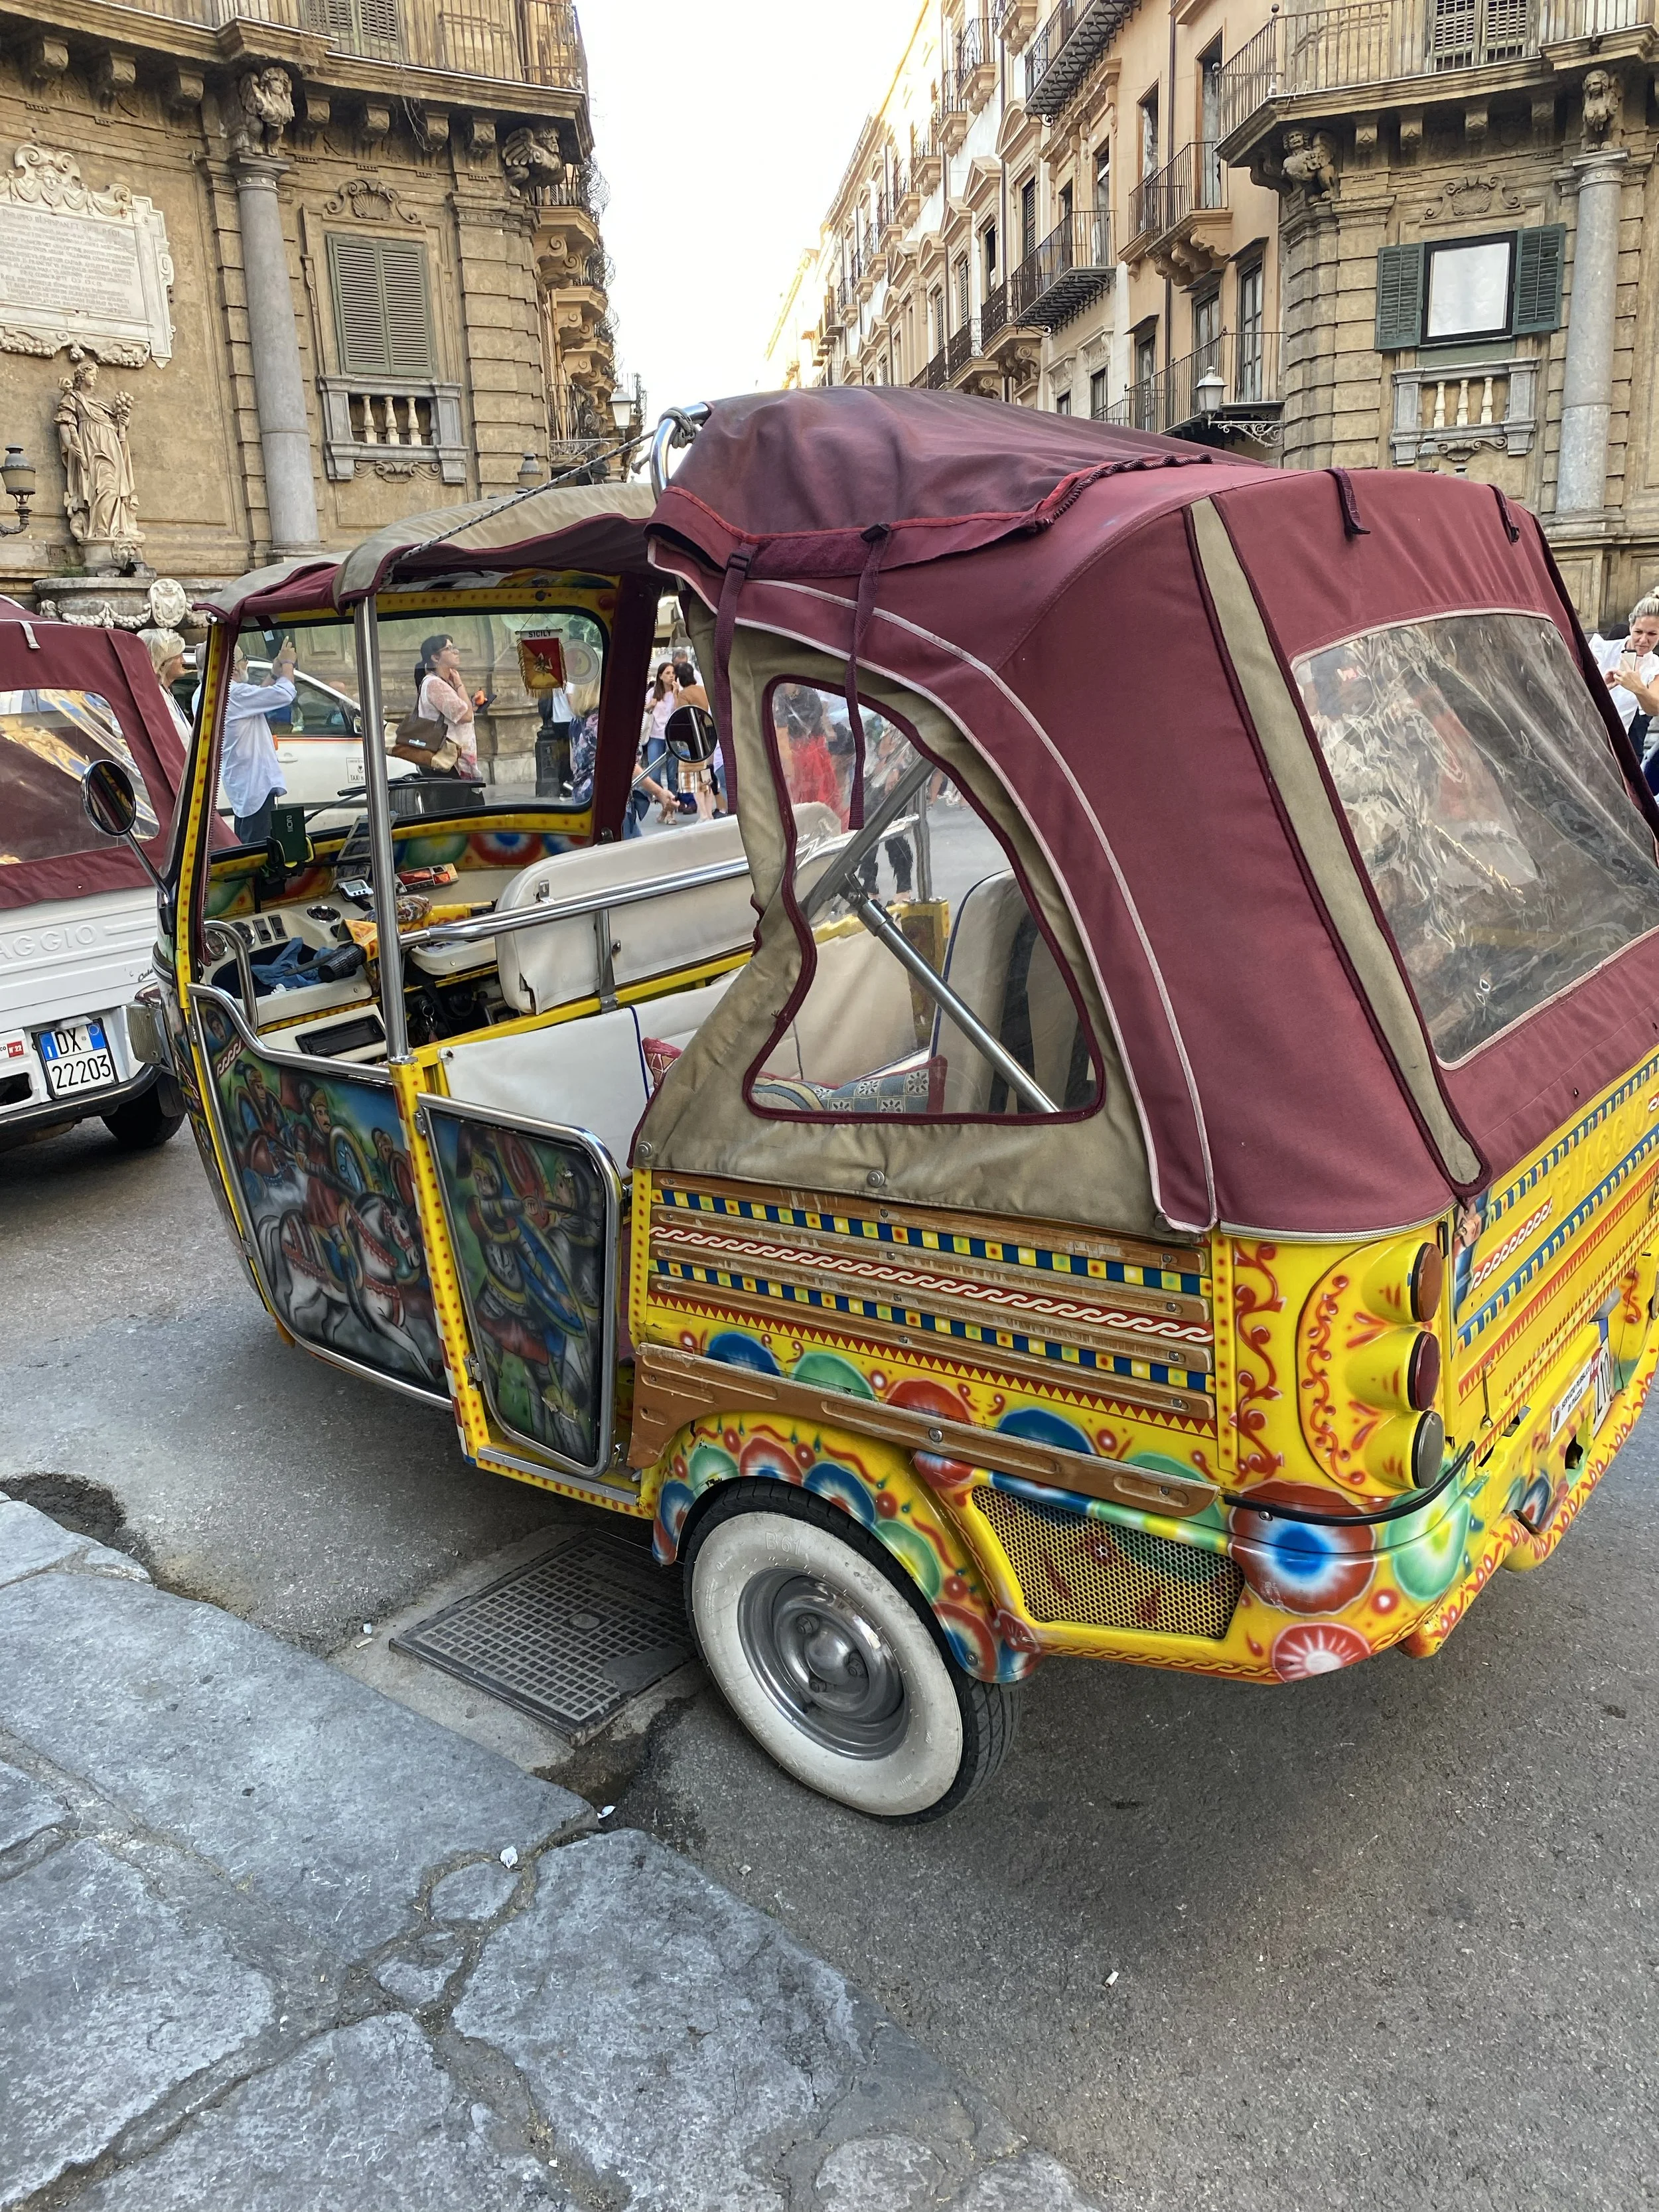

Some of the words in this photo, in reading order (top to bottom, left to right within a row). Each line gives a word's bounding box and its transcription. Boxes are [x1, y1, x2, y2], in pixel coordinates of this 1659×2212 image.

[54, 1027, 82, 1055] DX
[52, 1054, 111, 1090] 22203
[1557, 1096, 1645, 1216] PIAGGIO
